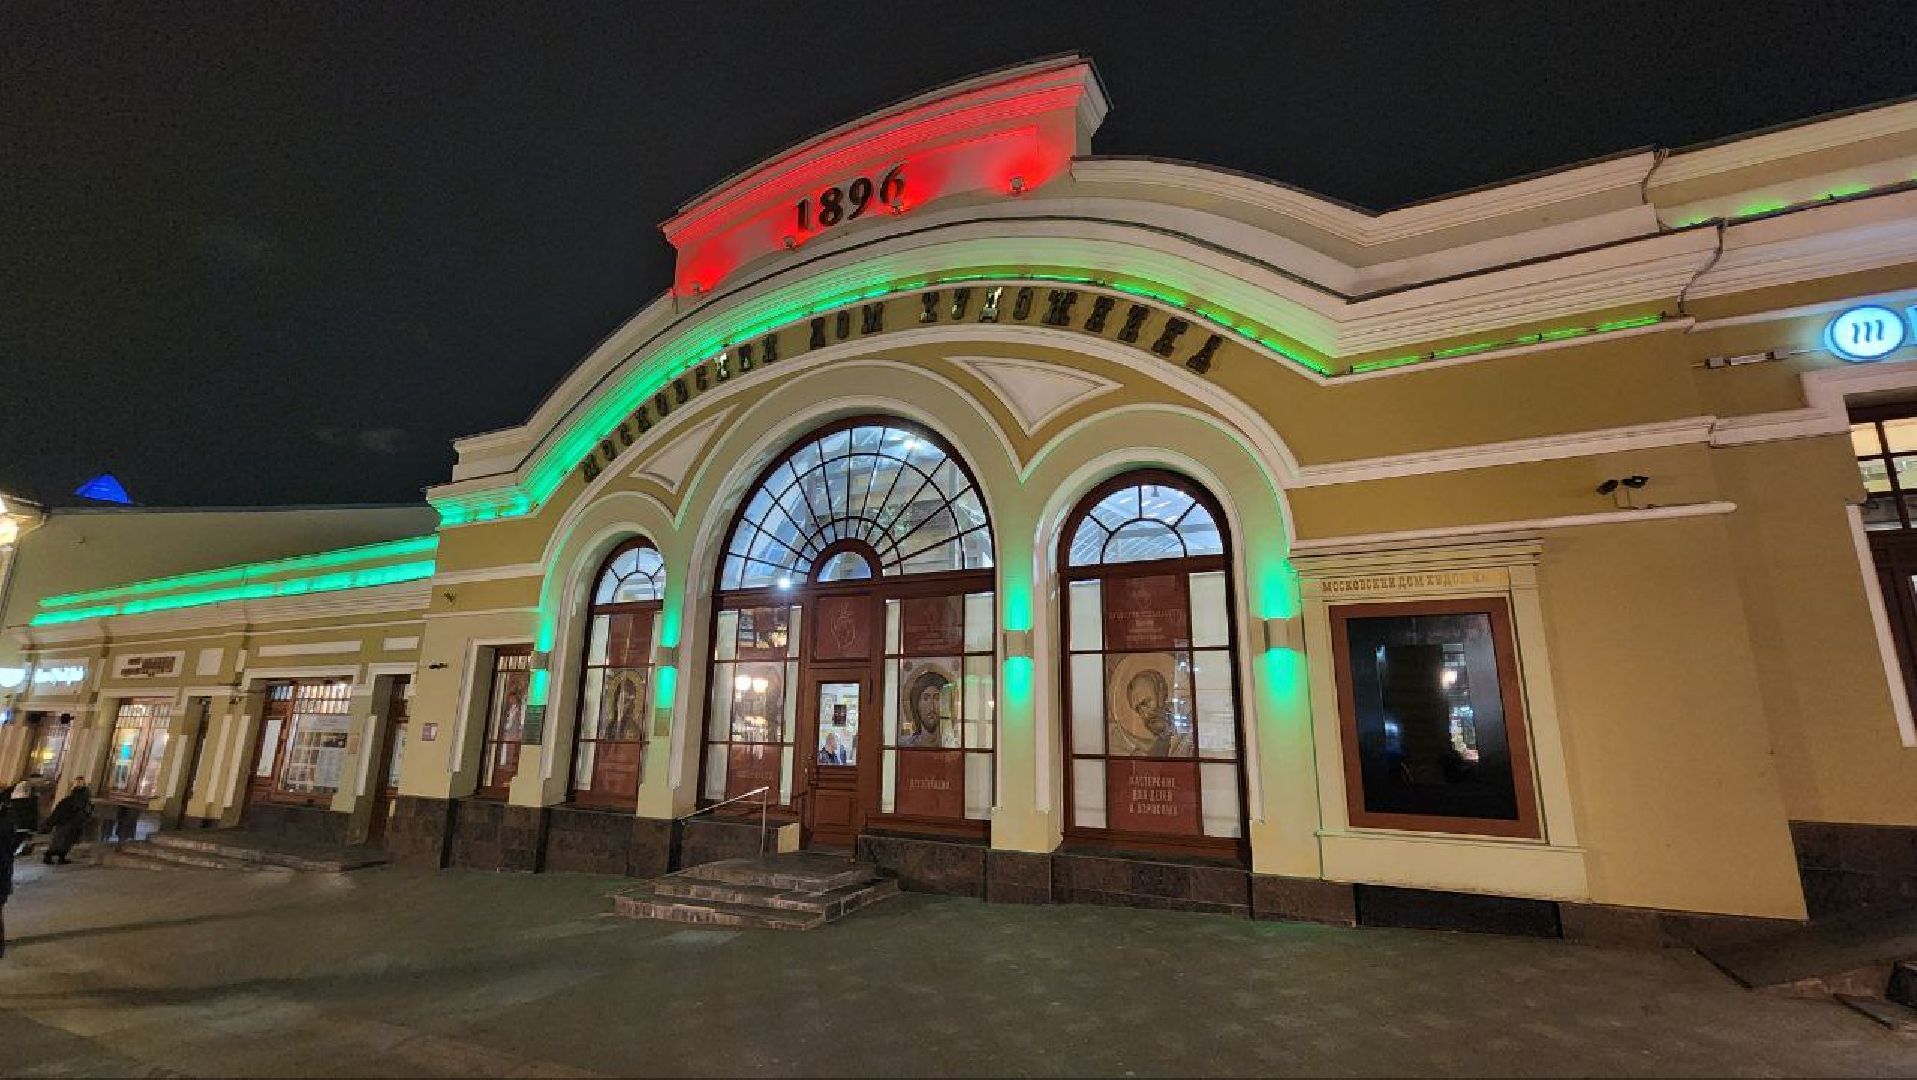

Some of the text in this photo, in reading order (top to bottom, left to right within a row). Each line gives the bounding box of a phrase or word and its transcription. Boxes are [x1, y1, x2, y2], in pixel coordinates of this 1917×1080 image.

[796, 161, 908, 232] 1896
[582, 286, 1223, 482] МОСКОВСКИЙ ДОМ ХУДОЖНИКА
[1398, 575, 1424, 589] ДОМ
